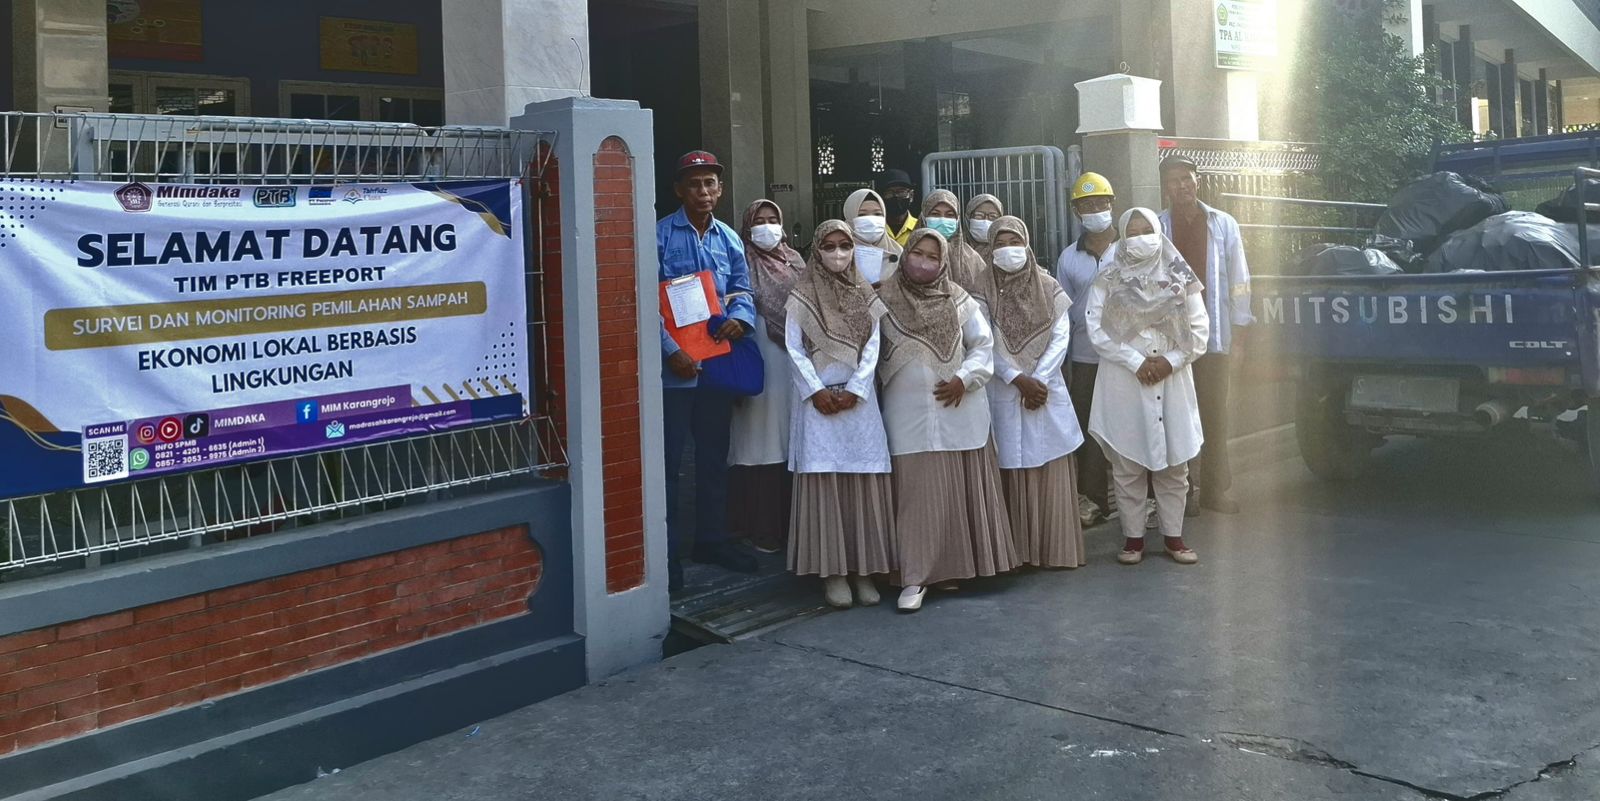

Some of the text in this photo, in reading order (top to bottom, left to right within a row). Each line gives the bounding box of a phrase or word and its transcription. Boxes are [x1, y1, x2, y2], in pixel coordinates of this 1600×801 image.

[258, 188, 292, 204] PTB
[77, 224, 457, 268] SELAMAT DATANG
[174, 266, 386, 293] TIM PTB FREEPORT
[73, 292, 468, 335] SURVEI DAN MONITORING PEMILAHAN SAMPAH
[1262, 294, 1513, 324] MITSUBISHI
[138, 326, 417, 370] EKONOMI LOKAL BERBASIS
[1508, 340, 1568, 349] COLT
[212, 360, 353, 394] LINGKUNGAN
[321, 395, 396, 413] MIM Karangrejo
[214, 413, 266, 428] MIMDAKA
[348, 409, 456, 430] madrasahkarangrejo@gmail.com
[88, 425, 124, 436] SCAN ME
[155, 440, 197, 452] INFO SPMB
[155, 451, 173, 459] 0821
[182, 447, 200, 455] 4201
[155, 459, 175, 468] 0857
[182, 455, 202, 464] 3053
